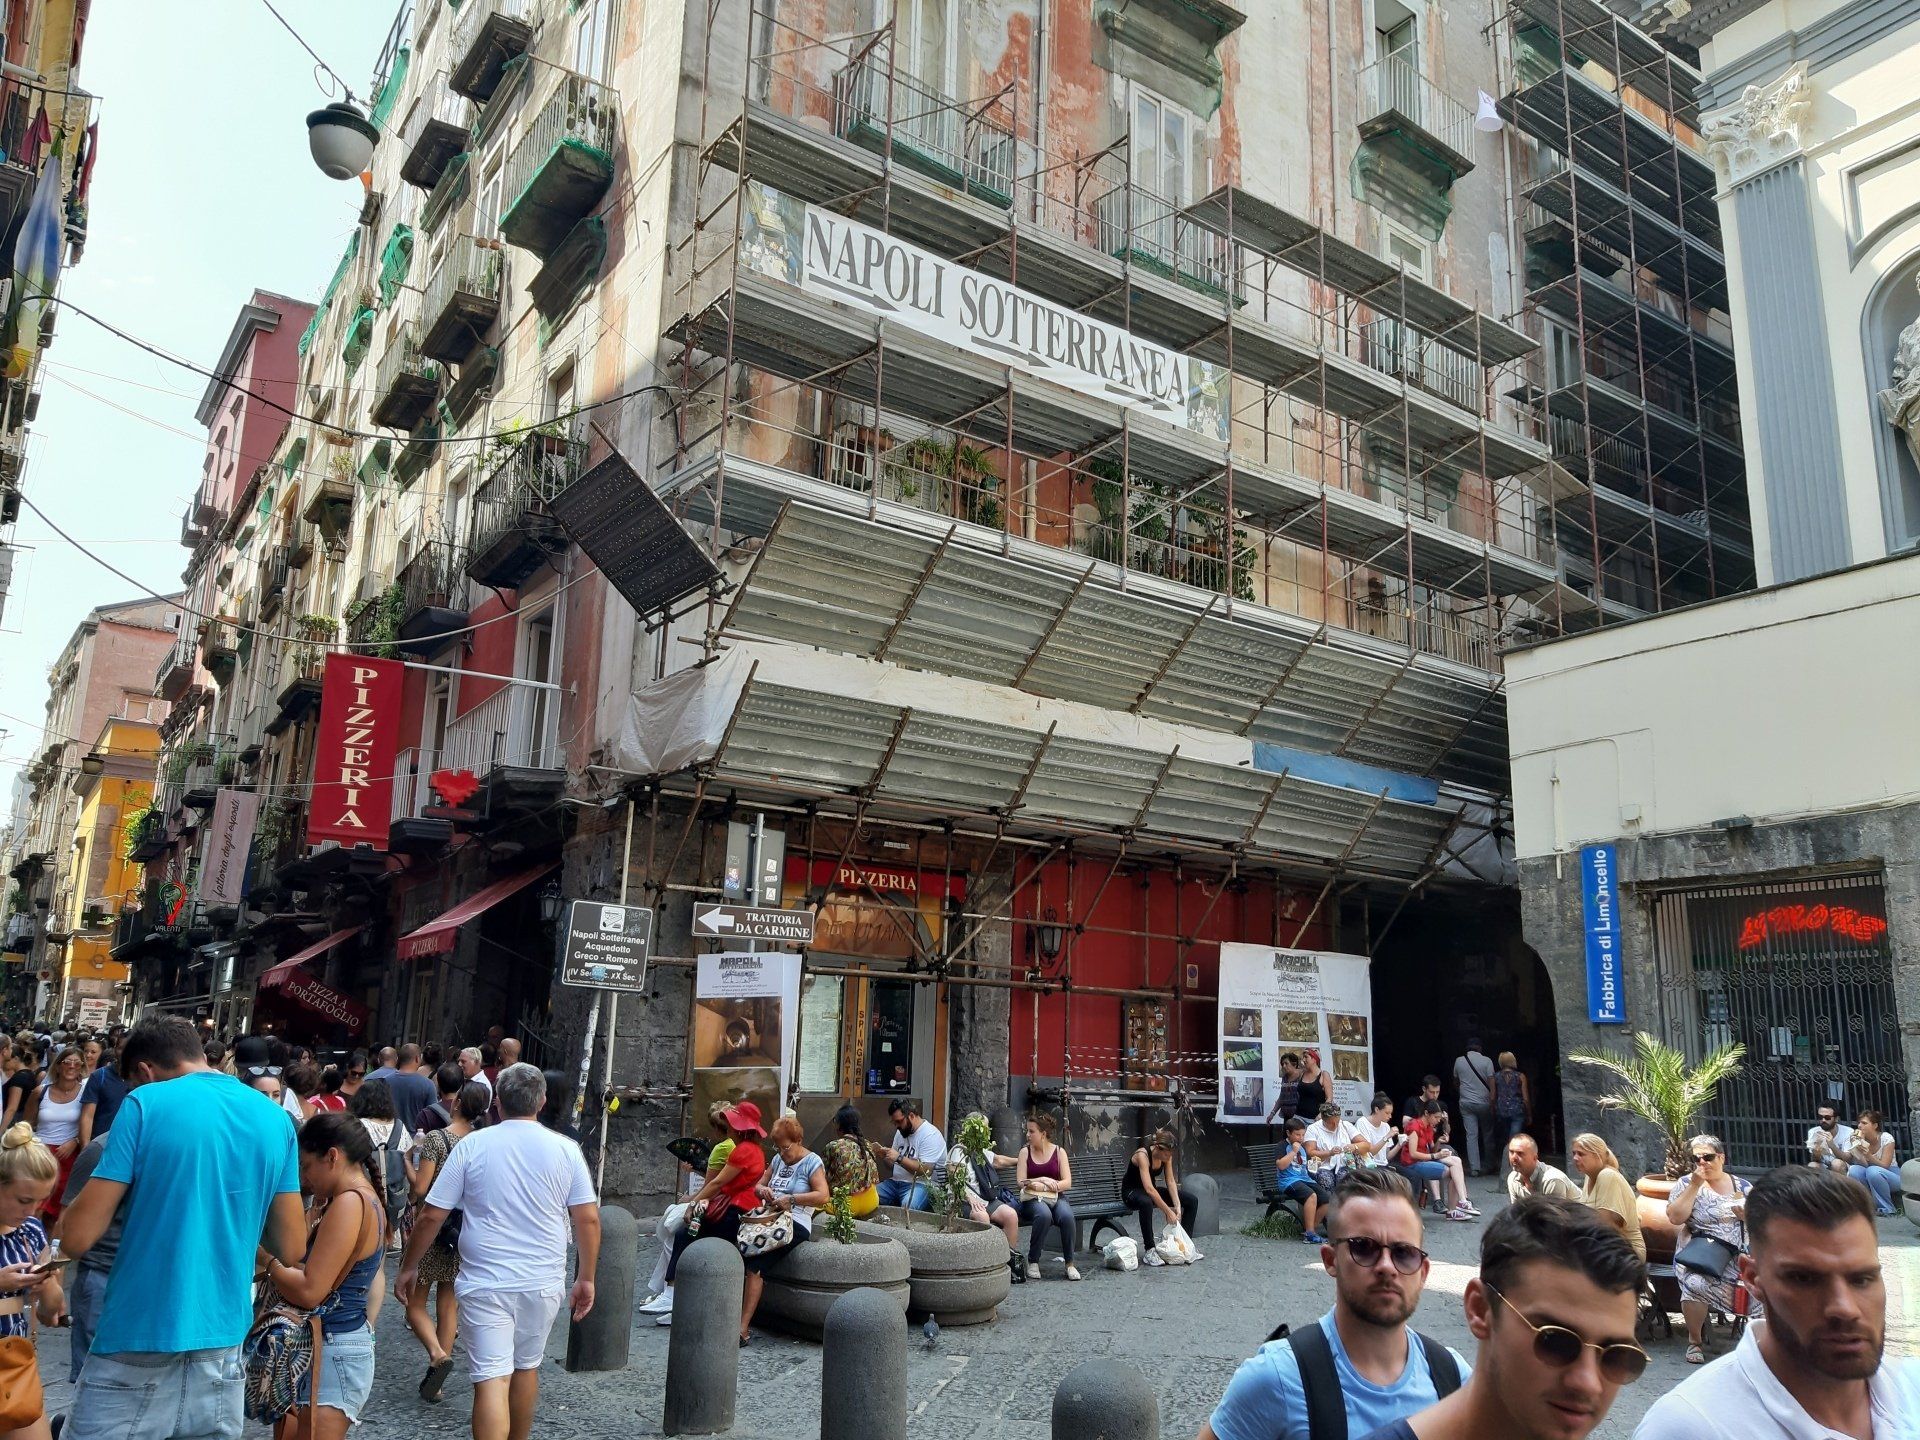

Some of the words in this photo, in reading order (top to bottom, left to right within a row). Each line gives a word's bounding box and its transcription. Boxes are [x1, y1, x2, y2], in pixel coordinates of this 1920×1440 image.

[805, 212, 945, 319] NAPOLI
[959, 274, 1186, 407] SOTTERRANEA
[333, 666, 378, 828] PIZZERIA
[213, 859, 228, 899] fattoria
[221, 832, 236, 858] degli
[229, 799, 241, 832] esposti
[839, 868, 917, 891] PIZZERIA
[1593, 849, 1611, 931] Limoncello
[154, 924, 181, 933] VALENTI
[745, 912, 802, 925] TRATTORIA
[572, 929, 599, 940] Napoli
[600, 932, 645, 945] Sotterranea
[735, 923, 752, 934] DA
[754, 925, 810, 938] CARMINE
[411, 936, 438, 956] PIZZERIA
[584, 941, 631, 953] Acquedotto
[1599, 935, 1611, 949] di
[574, 951, 599, 960] Greco
[605, 954, 638, 965] Romano
[1274, 953, 1317, 967] NAPOLI
[622, 972, 637, 981] Sec.
[1599, 953, 1616, 1019] Fabbrica
[287, 981, 360, 1028] PORTAFOGLIO
[307, 980, 339, 1005] PIZZA
[339, 998, 348, 1010] A
[855, 1010, 865, 1086] SPINGERE
